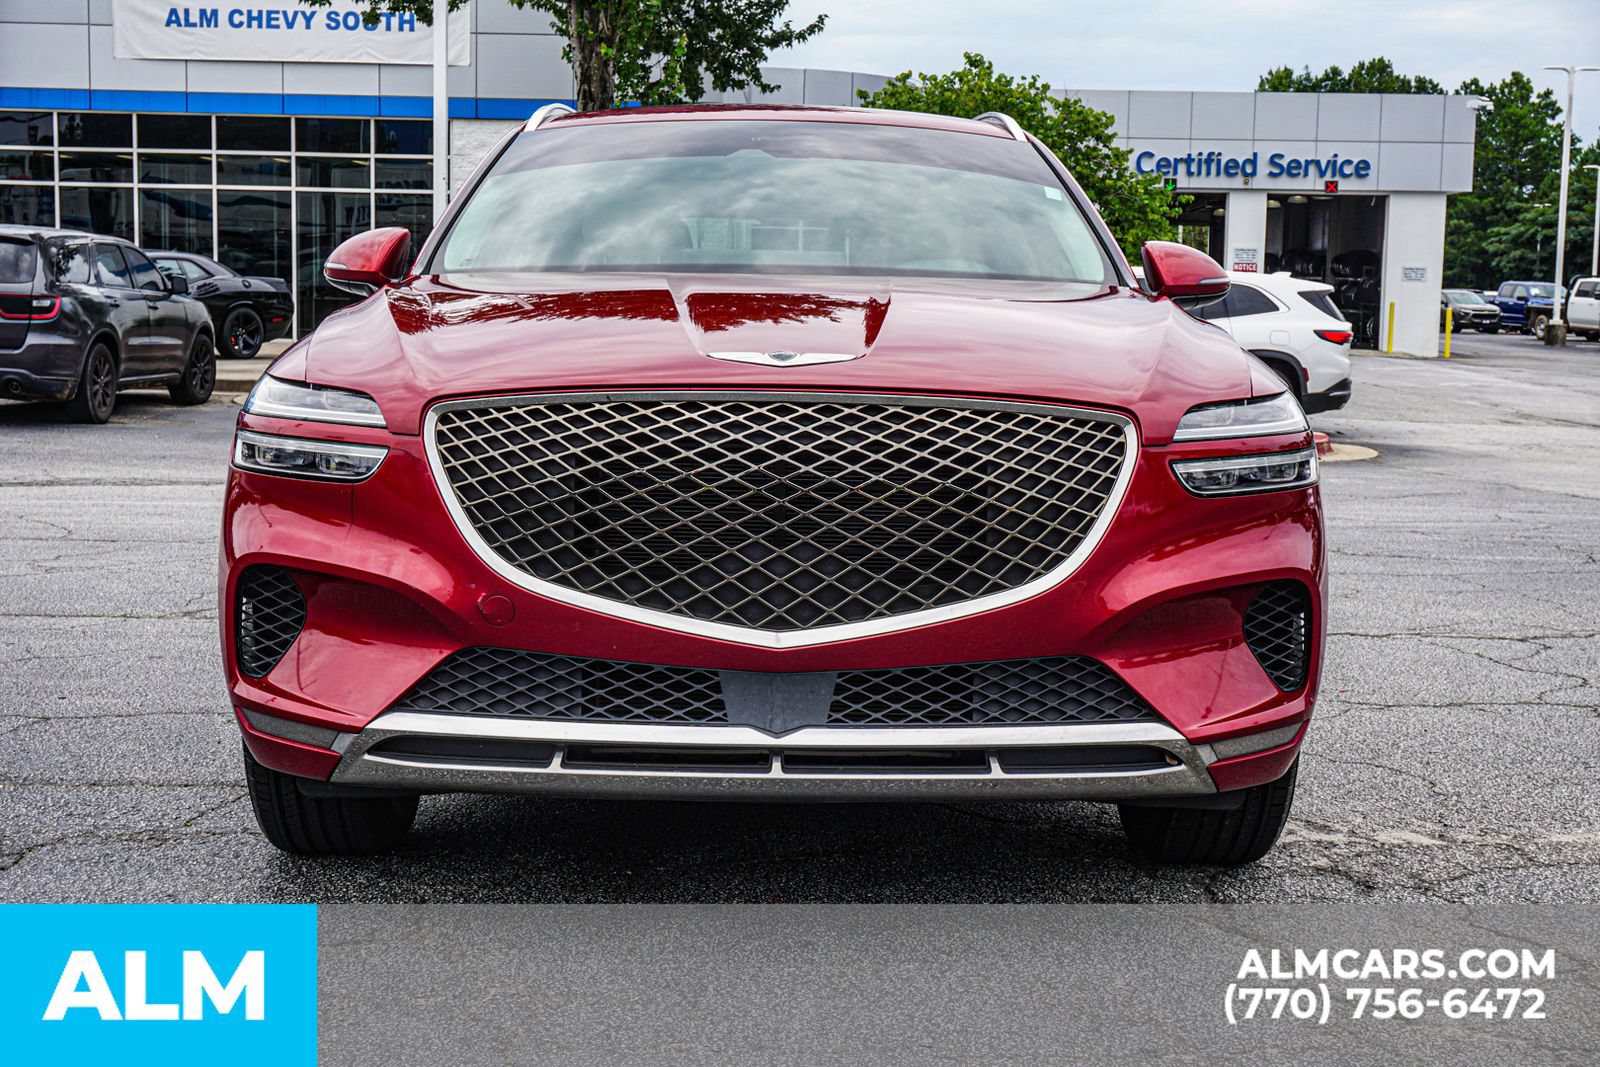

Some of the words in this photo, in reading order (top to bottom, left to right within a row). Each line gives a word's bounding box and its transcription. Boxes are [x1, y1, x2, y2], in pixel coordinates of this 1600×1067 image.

[165, 8, 219, 27] ALM
[228, 9, 317, 30] CHEVY
[1136, 151, 1258, 177] Certified
[1268, 153, 1371, 178] Service
[1234, 263, 1257, 271] NOTICE
